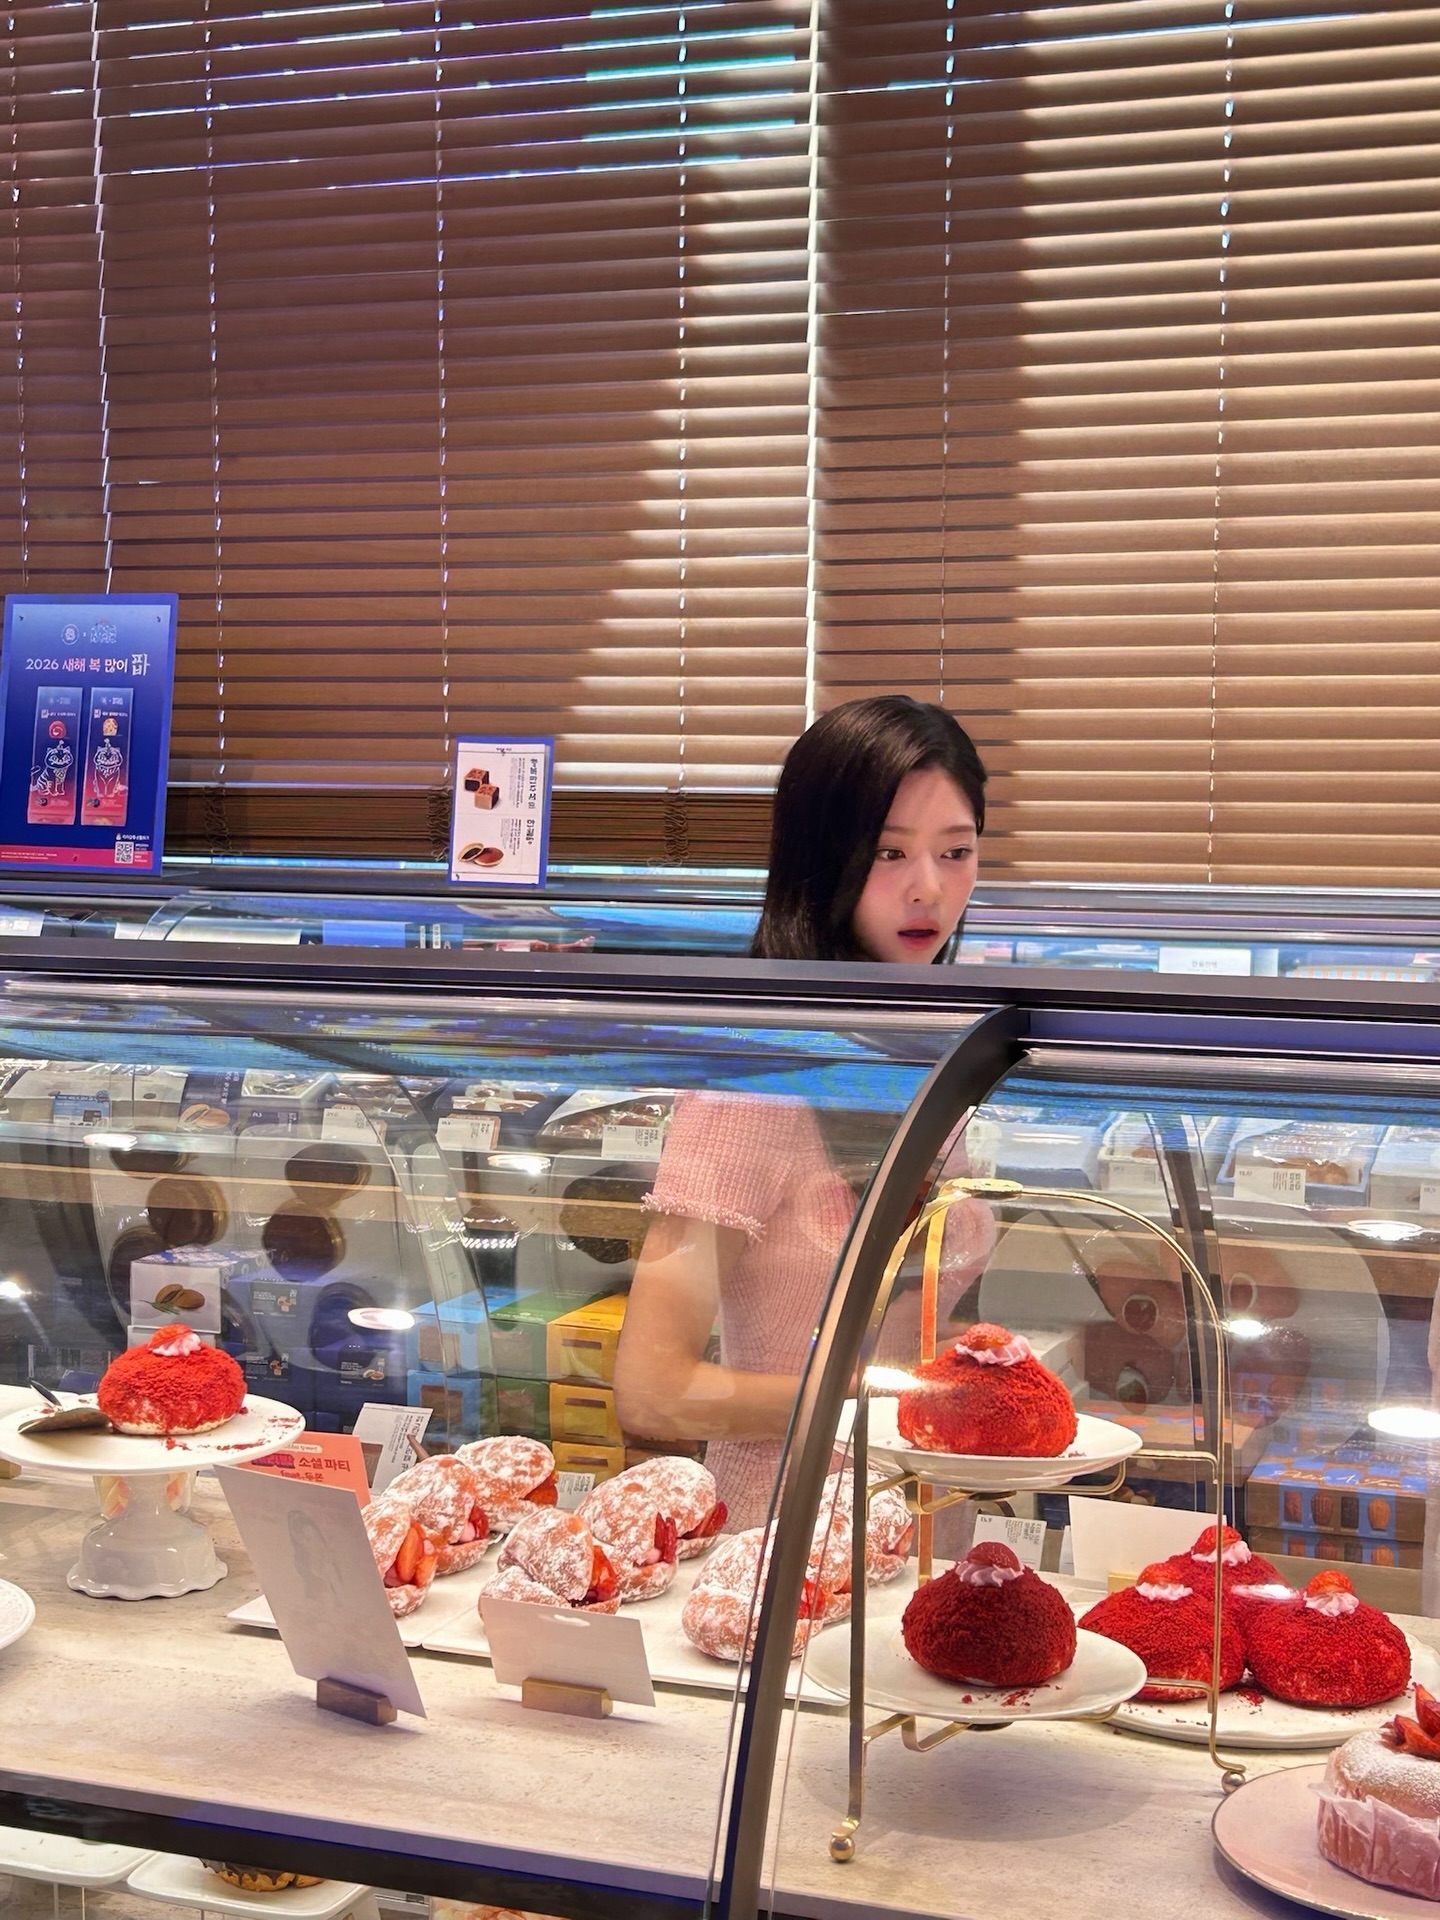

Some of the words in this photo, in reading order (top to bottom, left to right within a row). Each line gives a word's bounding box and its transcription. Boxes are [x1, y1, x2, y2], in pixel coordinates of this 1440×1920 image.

[25, 658, 59, 670] 2026
[62, 658, 86, 673] 새해
[89, 658, 101, 673] 복
[104, 658, 128, 673] 많이
